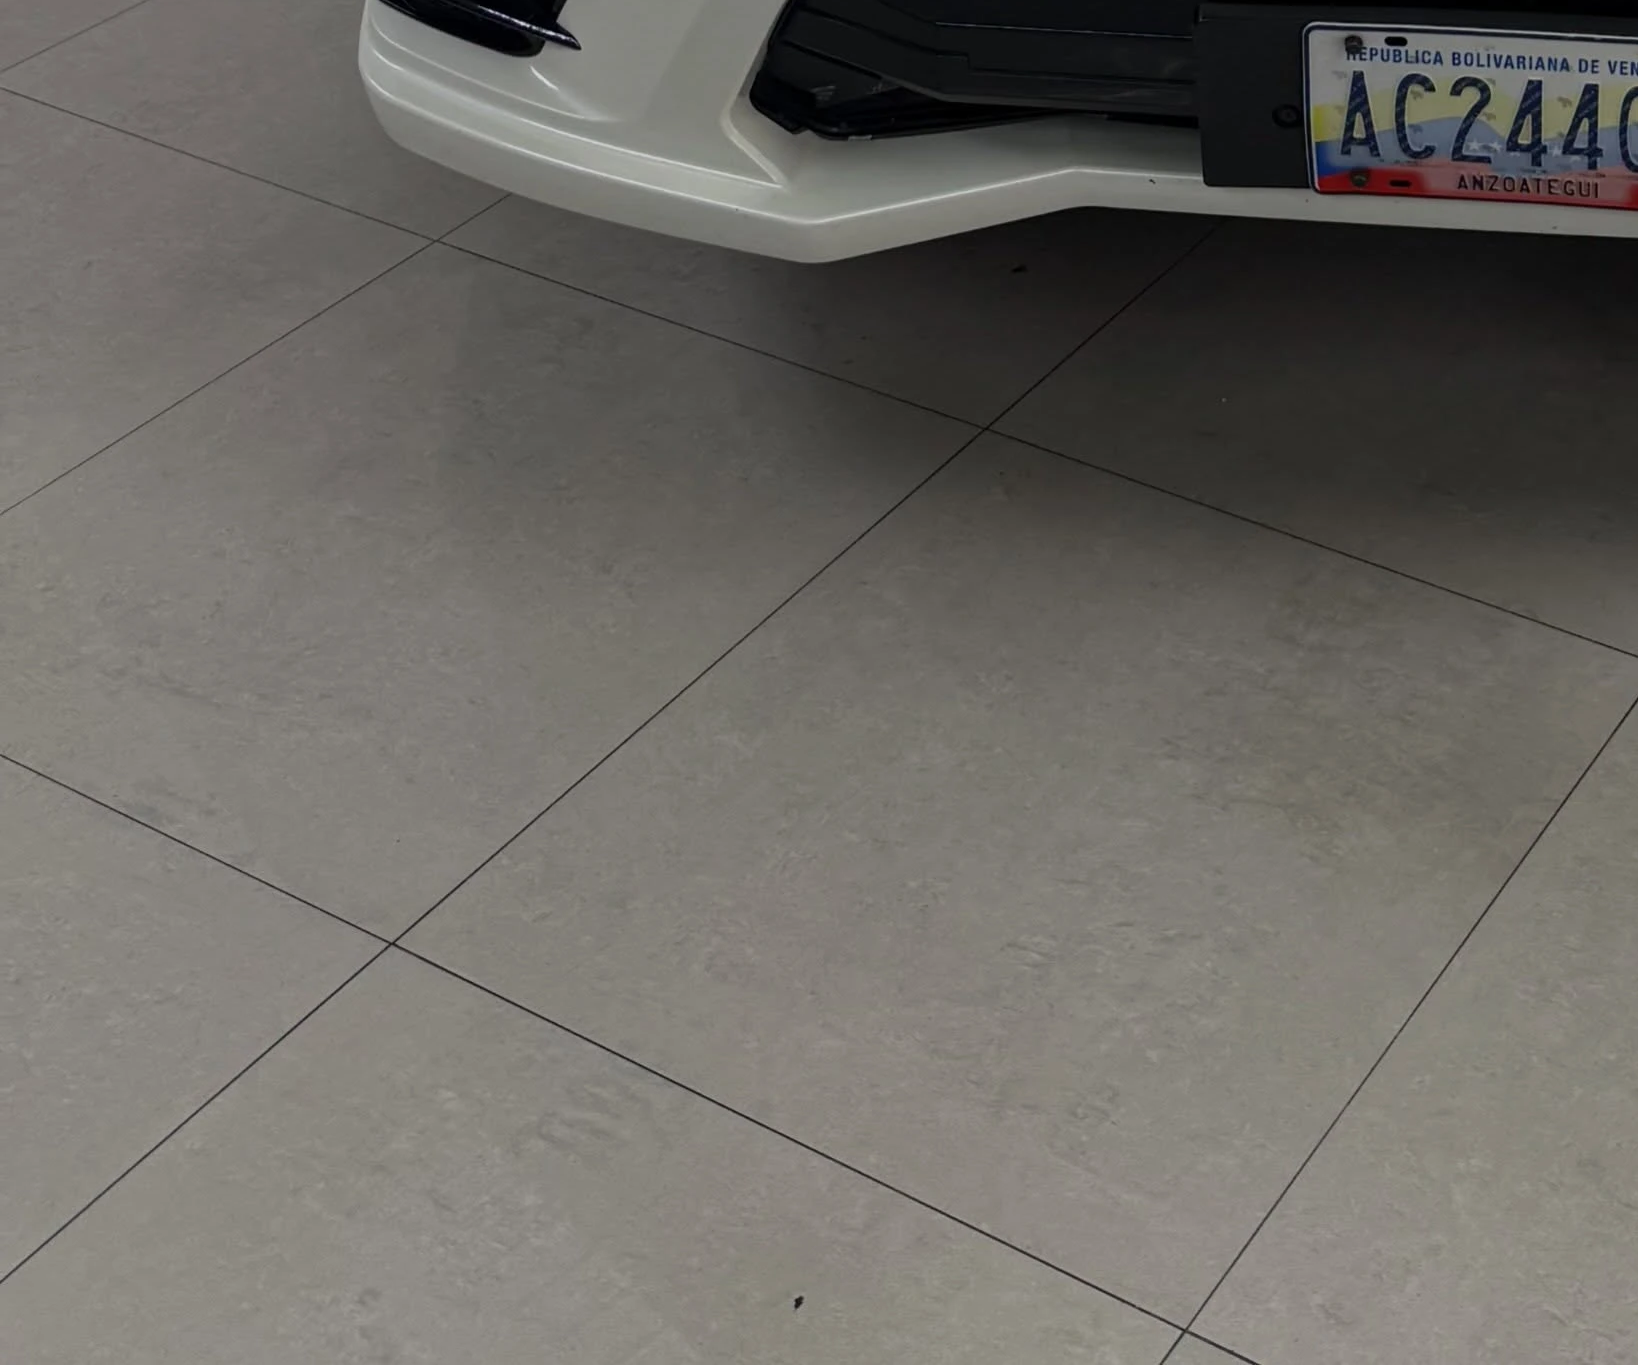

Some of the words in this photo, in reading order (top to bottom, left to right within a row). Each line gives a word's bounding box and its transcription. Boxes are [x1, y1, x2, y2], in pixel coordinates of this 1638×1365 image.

[1452, 51, 1570, 73] BOLIVARIANA
[1578, 58, 1600, 74] DE
[1456, 174, 1600, 199] ANZOATEGUI
